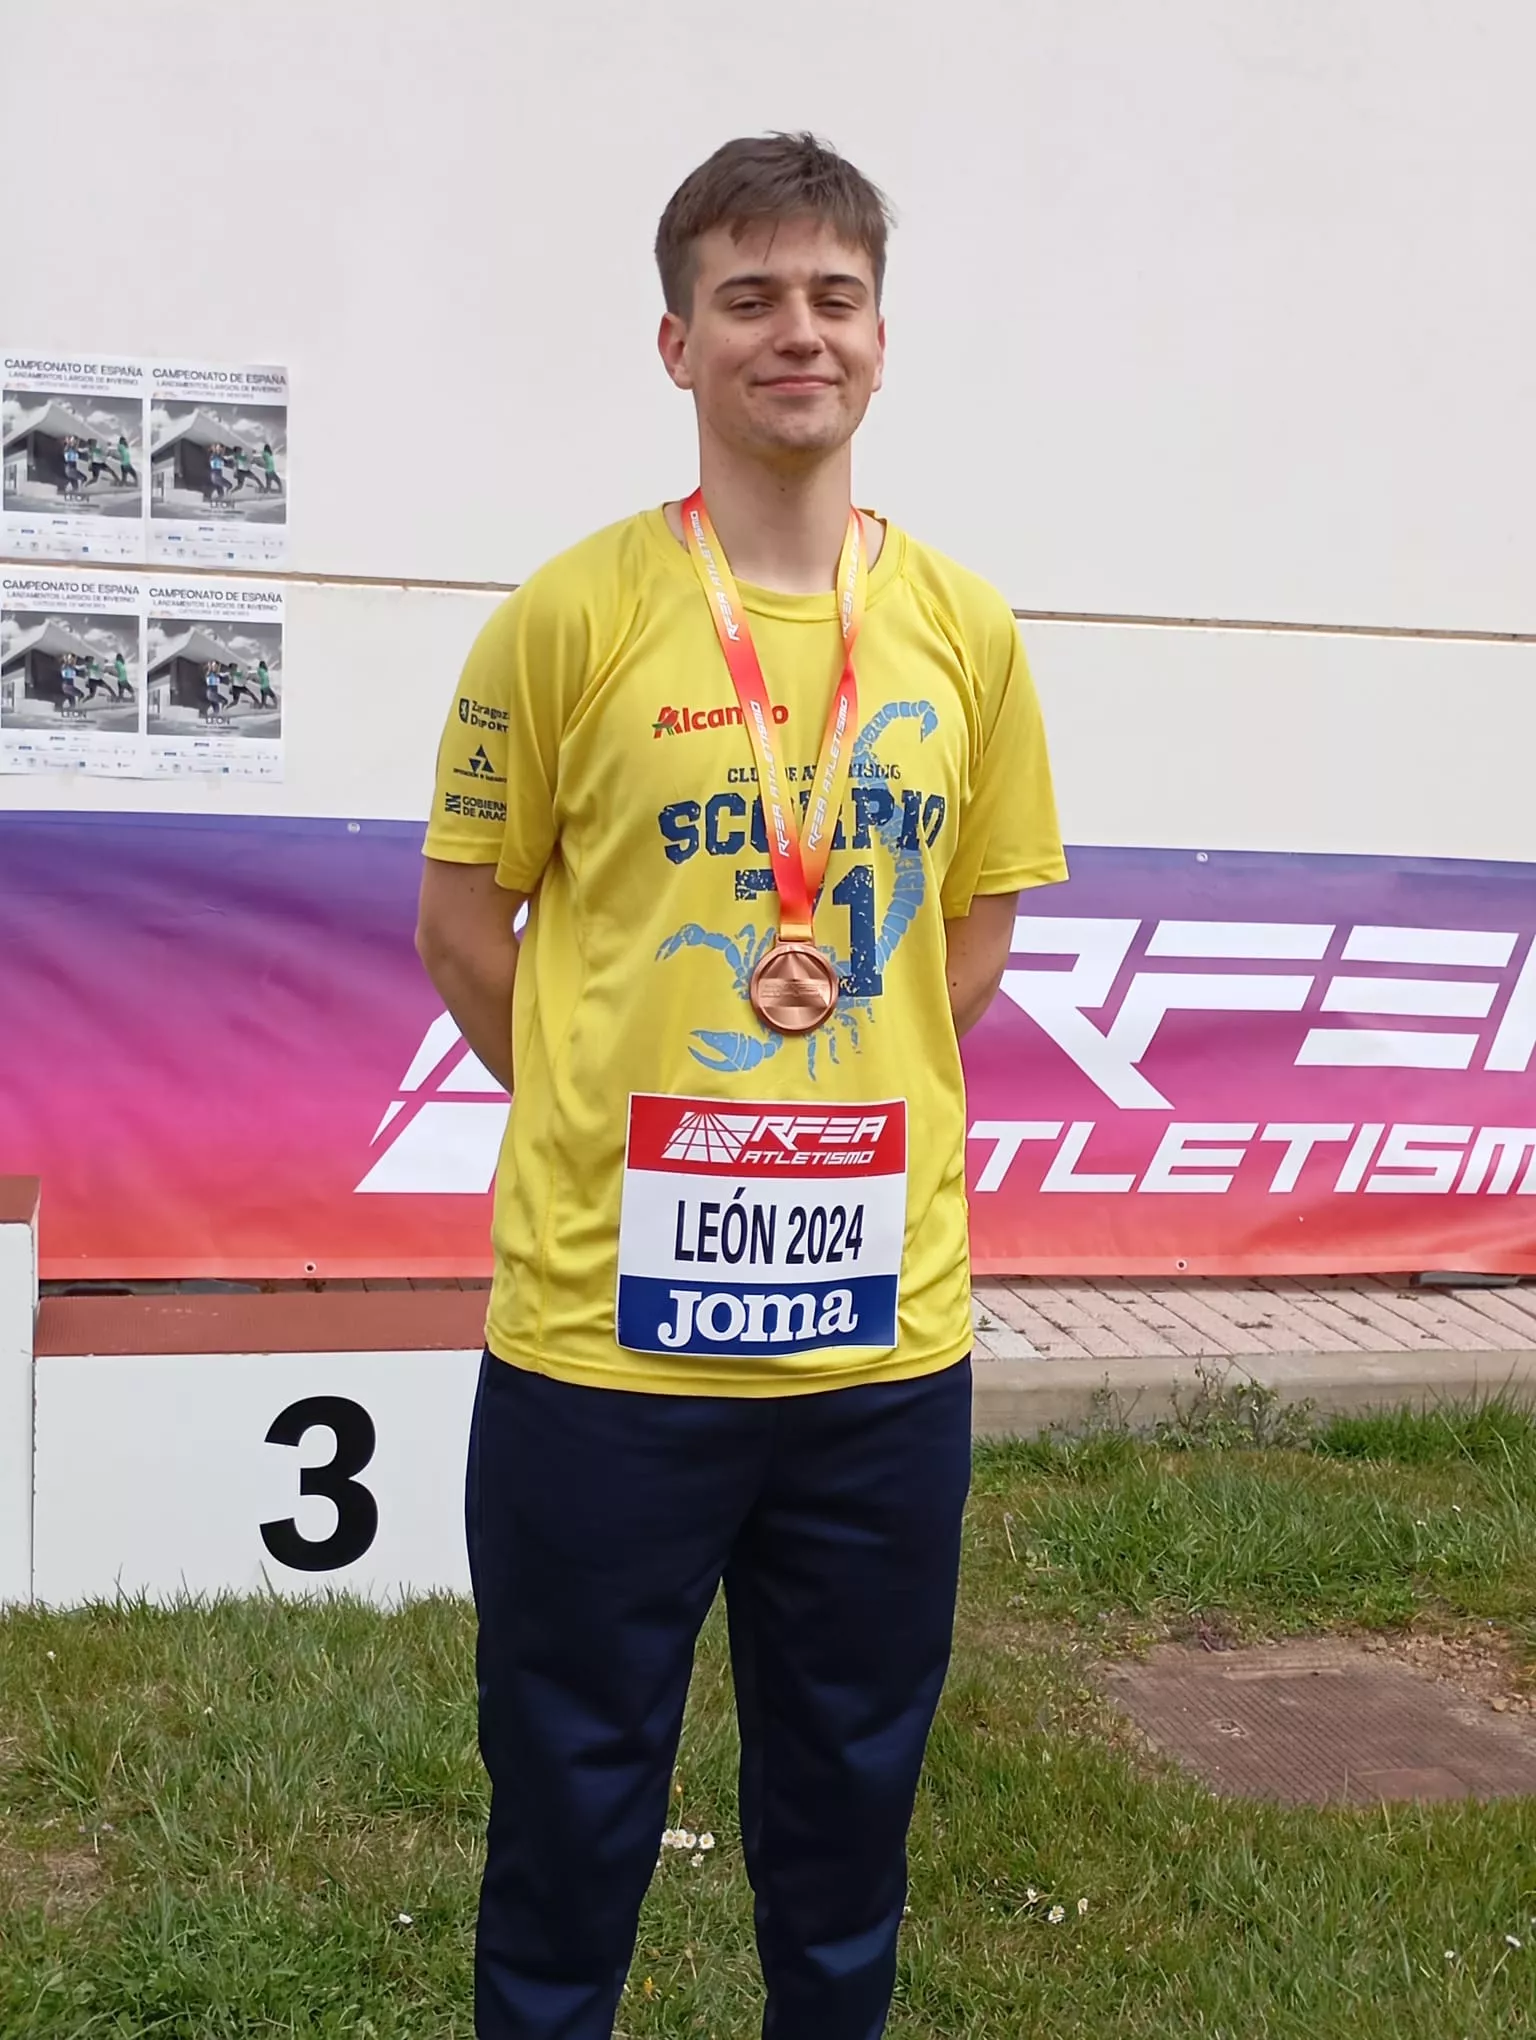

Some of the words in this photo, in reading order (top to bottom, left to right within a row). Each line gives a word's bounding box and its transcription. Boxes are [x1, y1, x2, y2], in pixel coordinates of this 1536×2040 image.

[4, 359, 81, 373] CAMPEONATO
[84, 363, 97, 375] DE
[101, 364, 143, 377] ESPAÑA
[152, 368, 227, 382] CAMPEONATO
[230, 373, 243, 383] DE
[246, 373, 286, 385] ESPAÑA
[3, 580, 79, 592] CAMPEONATO
[82, 583, 95, 593] DE
[98, 583, 140, 595] ESPAÑA
[149, 588, 224, 601] CAMPEONATO
[226, 591, 238, 601] DE
[242, 591, 283, 603] ESPAÑA
[652, 706, 789, 739] Alcamo
[823, 695, 848, 794] ATLETISMO
[727, 766, 759, 783] CLU
[463, 796, 507, 812] GOBIERN
[463, 806, 476, 818] DE
[751, 1115, 888, 1151] RFEA
[741, 1150, 875, 1165] ATLETISMO
[967, 1120, 1536, 1194] TLETISM
[674, 1187, 777, 1265] LEÓN
[785, 1204, 864, 1265] 2024
[657, 1289, 858, 1348] Joma
[259, 1395, 378, 1572] 3
